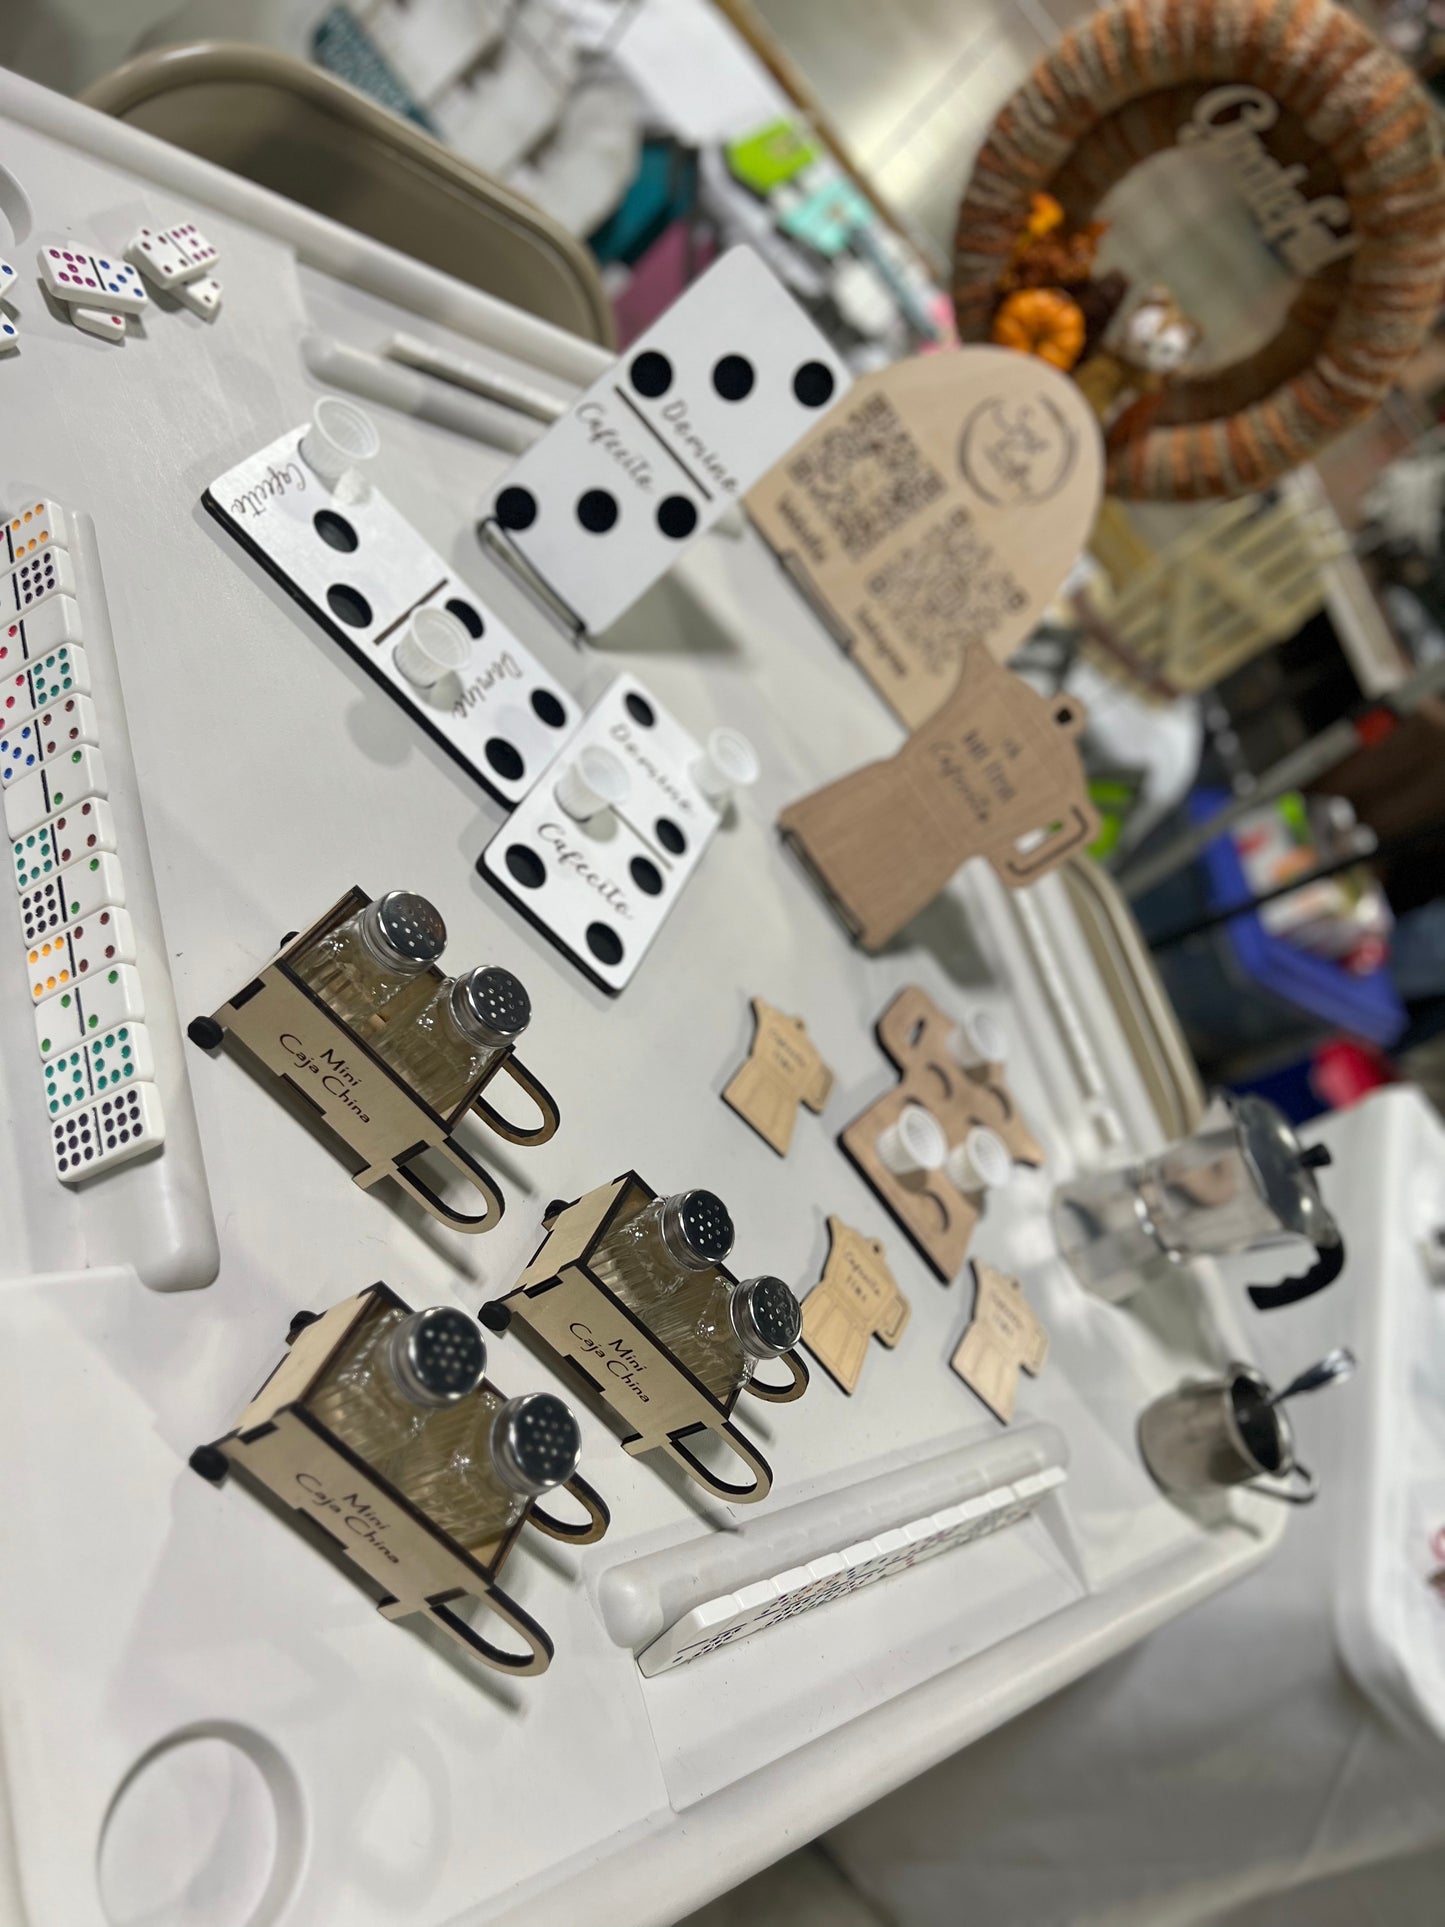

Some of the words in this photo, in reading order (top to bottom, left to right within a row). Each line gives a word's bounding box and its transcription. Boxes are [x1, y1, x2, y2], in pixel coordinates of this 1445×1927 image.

[230, 462, 306, 518] Cafecito
[575, 402, 653, 493] Cafecito
[661, 399, 738, 493] Domino
[609, 724, 694, 815] Domino
[538, 823, 633, 919] Cafecito
[280, 1033, 320, 1074] Caja
[322, 1075, 370, 1123] China
[320, 1048, 362, 1087] Mini
[569, 1323, 606, 1358] Caja
[606, 1360, 650, 1403] China
[608, 1338, 648, 1372] Mini
[295, 1473, 342, 1513] Caja
[344, 1516, 400, 1564] China
[342, 1493, 391, 1531] Mini
